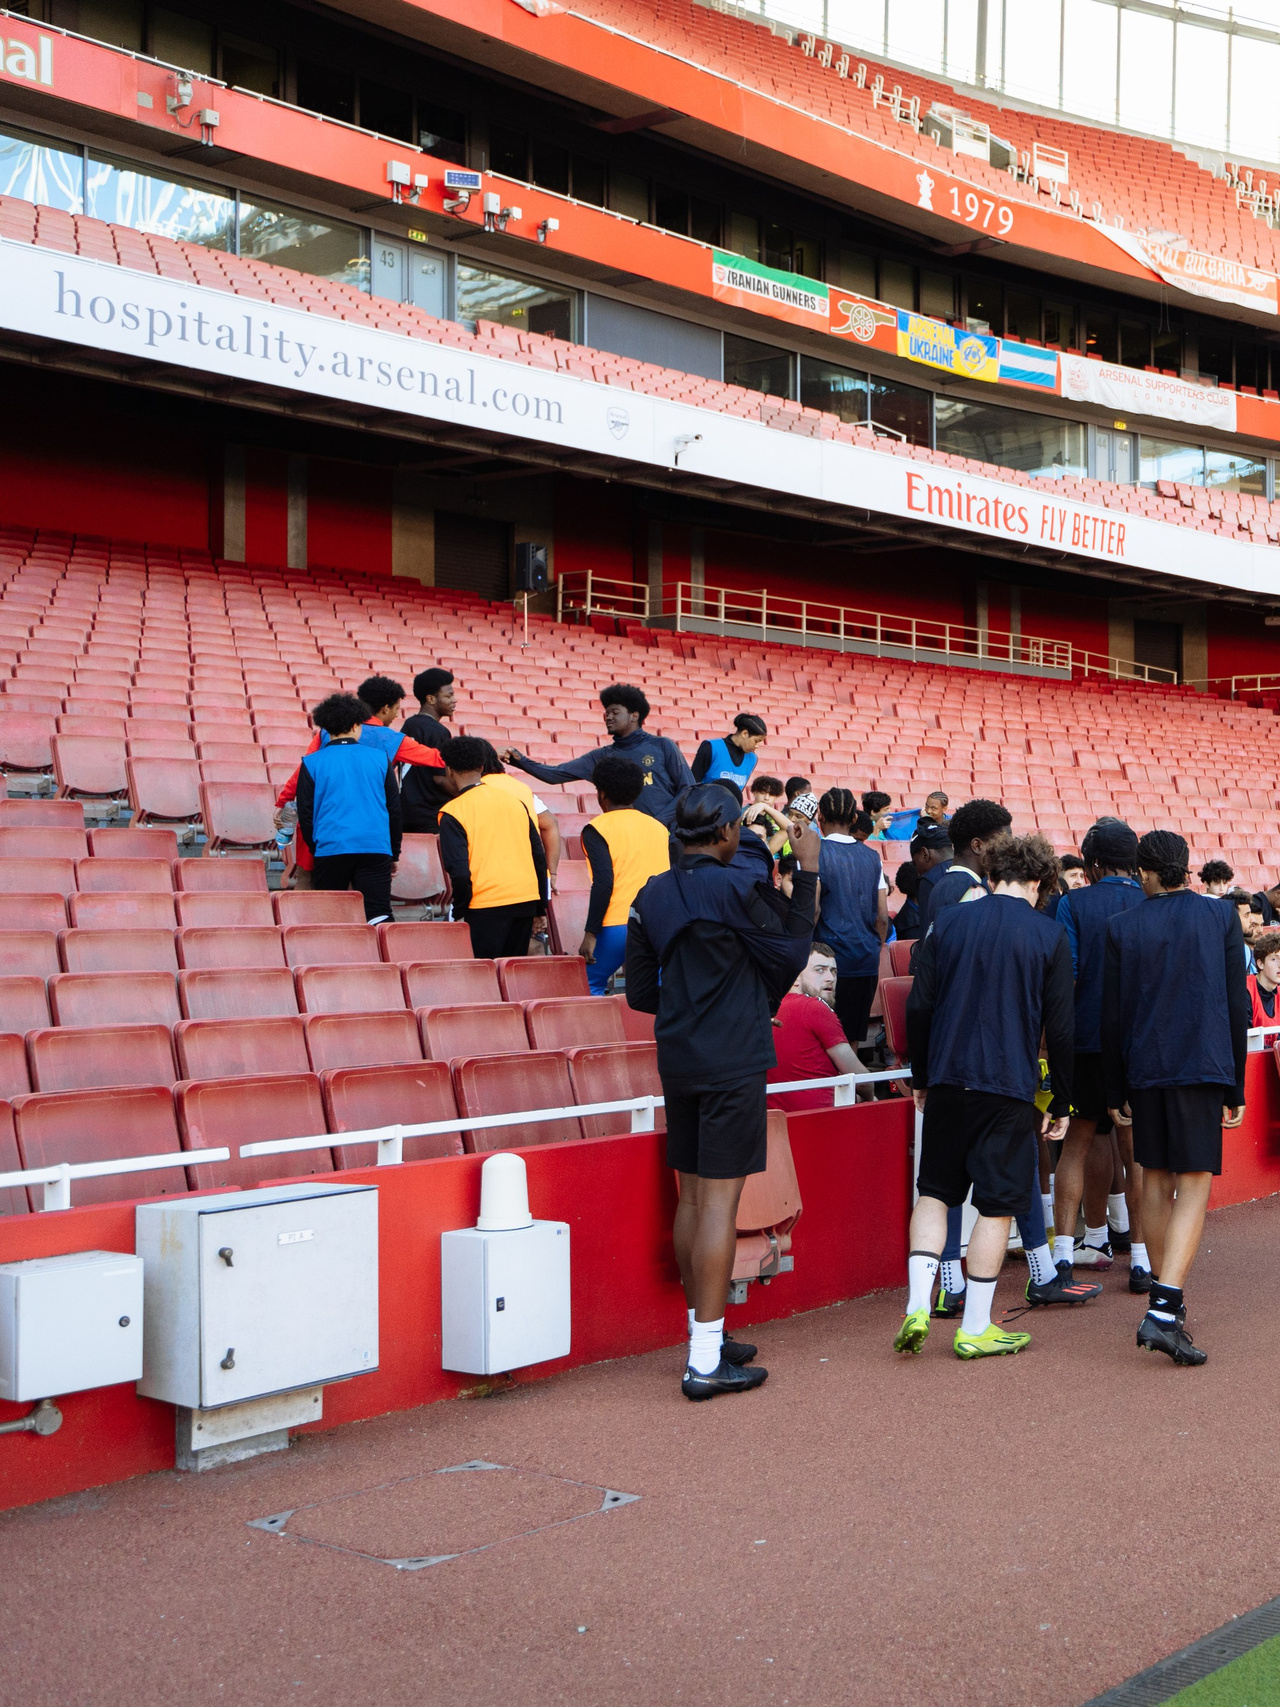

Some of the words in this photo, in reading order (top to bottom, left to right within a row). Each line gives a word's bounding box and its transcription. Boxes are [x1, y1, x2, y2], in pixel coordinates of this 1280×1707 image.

[949, 187, 1014, 235] 1979
[379, 250, 395, 268] 43
[1184, 253, 1246, 288] BULGARIA
[727, 270, 770, 296] IRANIAN
[772, 284, 817, 311] GUNNERS
[53, 270, 565, 425] hospitality.arsenal.com
[907, 315, 957, 349] ARSENAL
[909, 336, 955, 368] UKRAINE
[1099, 368, 1143, 387] ARSENAL
[1145, 378, 1206, 401] SUPPORTERS
[1206, 393, 1230, 406] CLUB
[905, 471, 1030, 535] Emirates
[1040, 504, 1067, 543] FLY
[1072, 512, 1126, 557] BETTER
